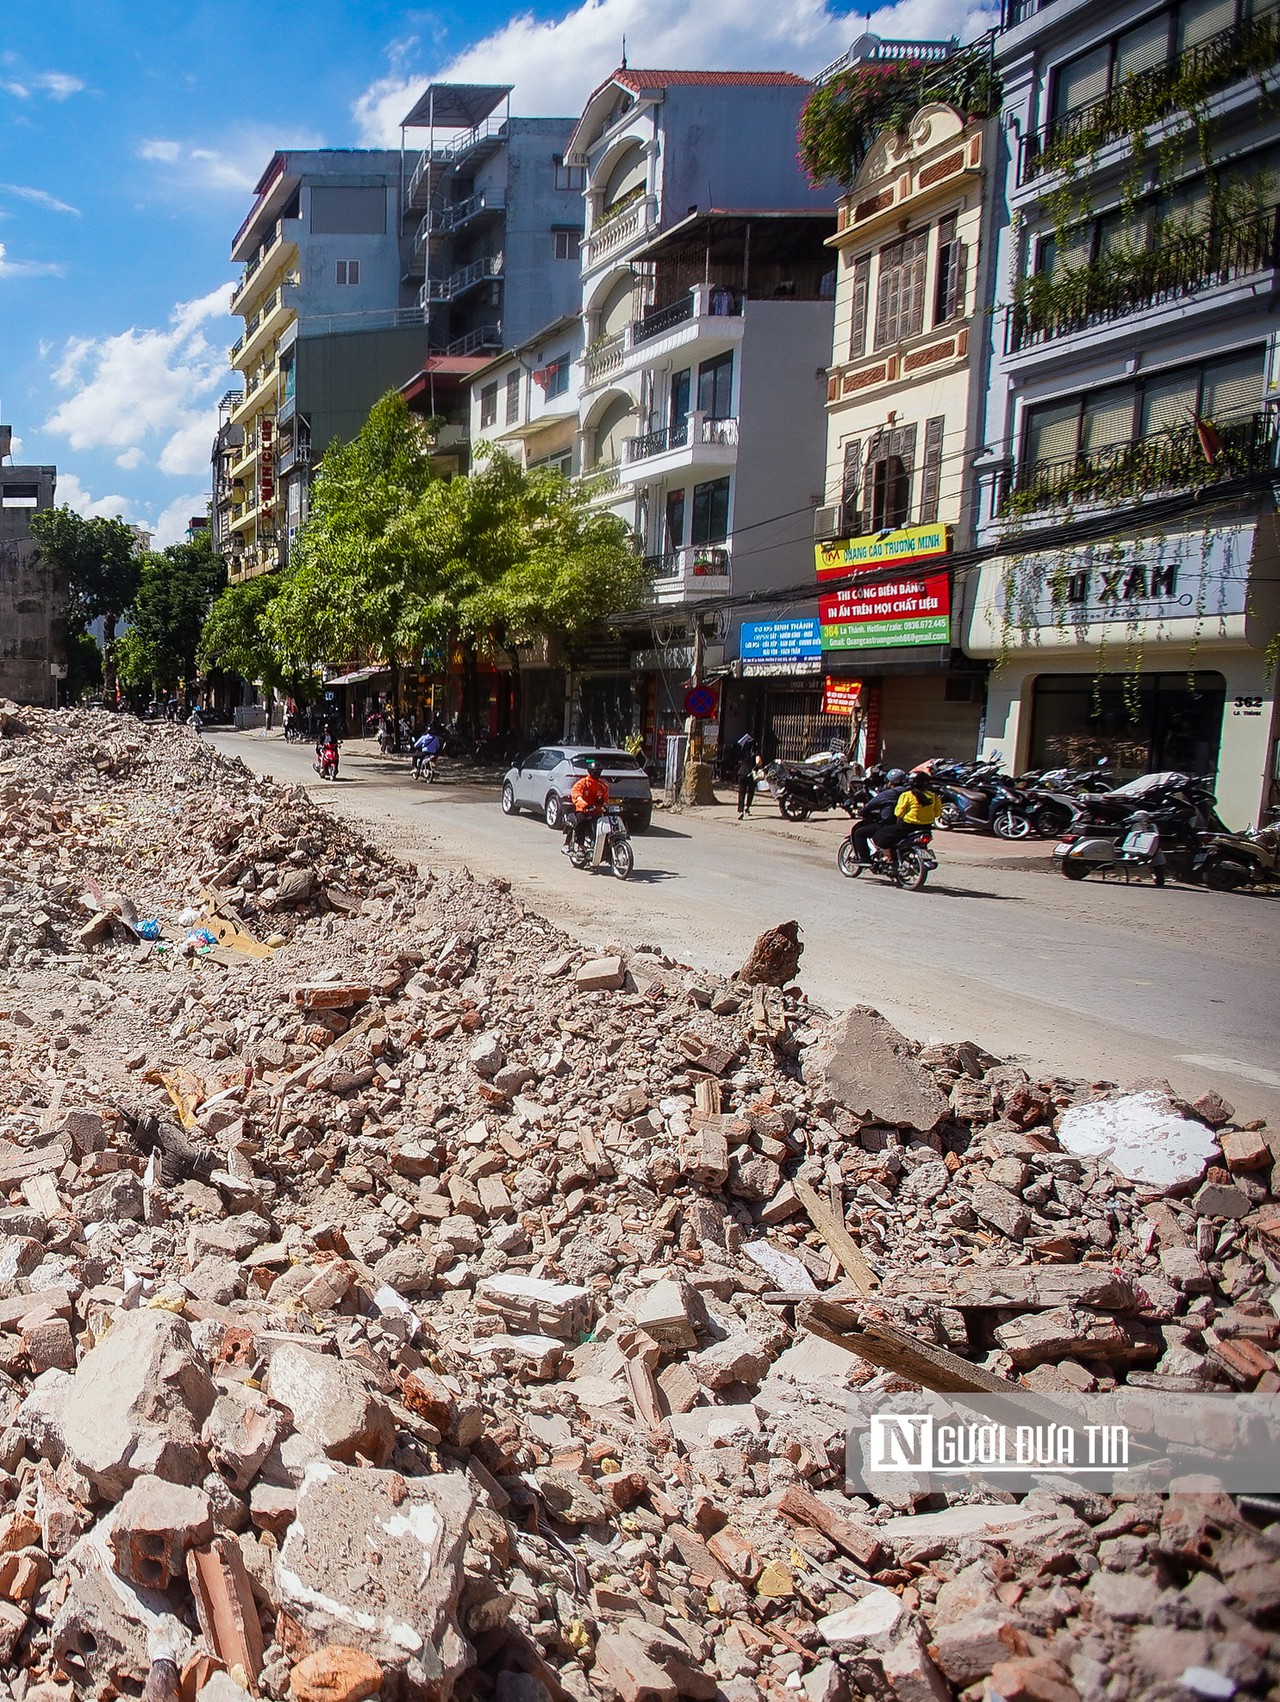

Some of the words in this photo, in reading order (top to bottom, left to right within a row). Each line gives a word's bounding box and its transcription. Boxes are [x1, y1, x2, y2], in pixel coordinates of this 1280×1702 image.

[918, 534, 940, 549] MINH
[837, 590, 851, 601] THI
[852, 587, 876, 600] CÔNG
[828, 608, 838, 618] IN
[839, 604, 851, 617] ẤN
[852, 603, 872, 616] TRÊN
[874, 602, 891, 615] MỌI
[893, 598, 917, 612] CHẤT
[919, 596, 938, 611] LIỆU
[840, 626, 848, 635] La
[1234, 696, 1263, 708] 362
